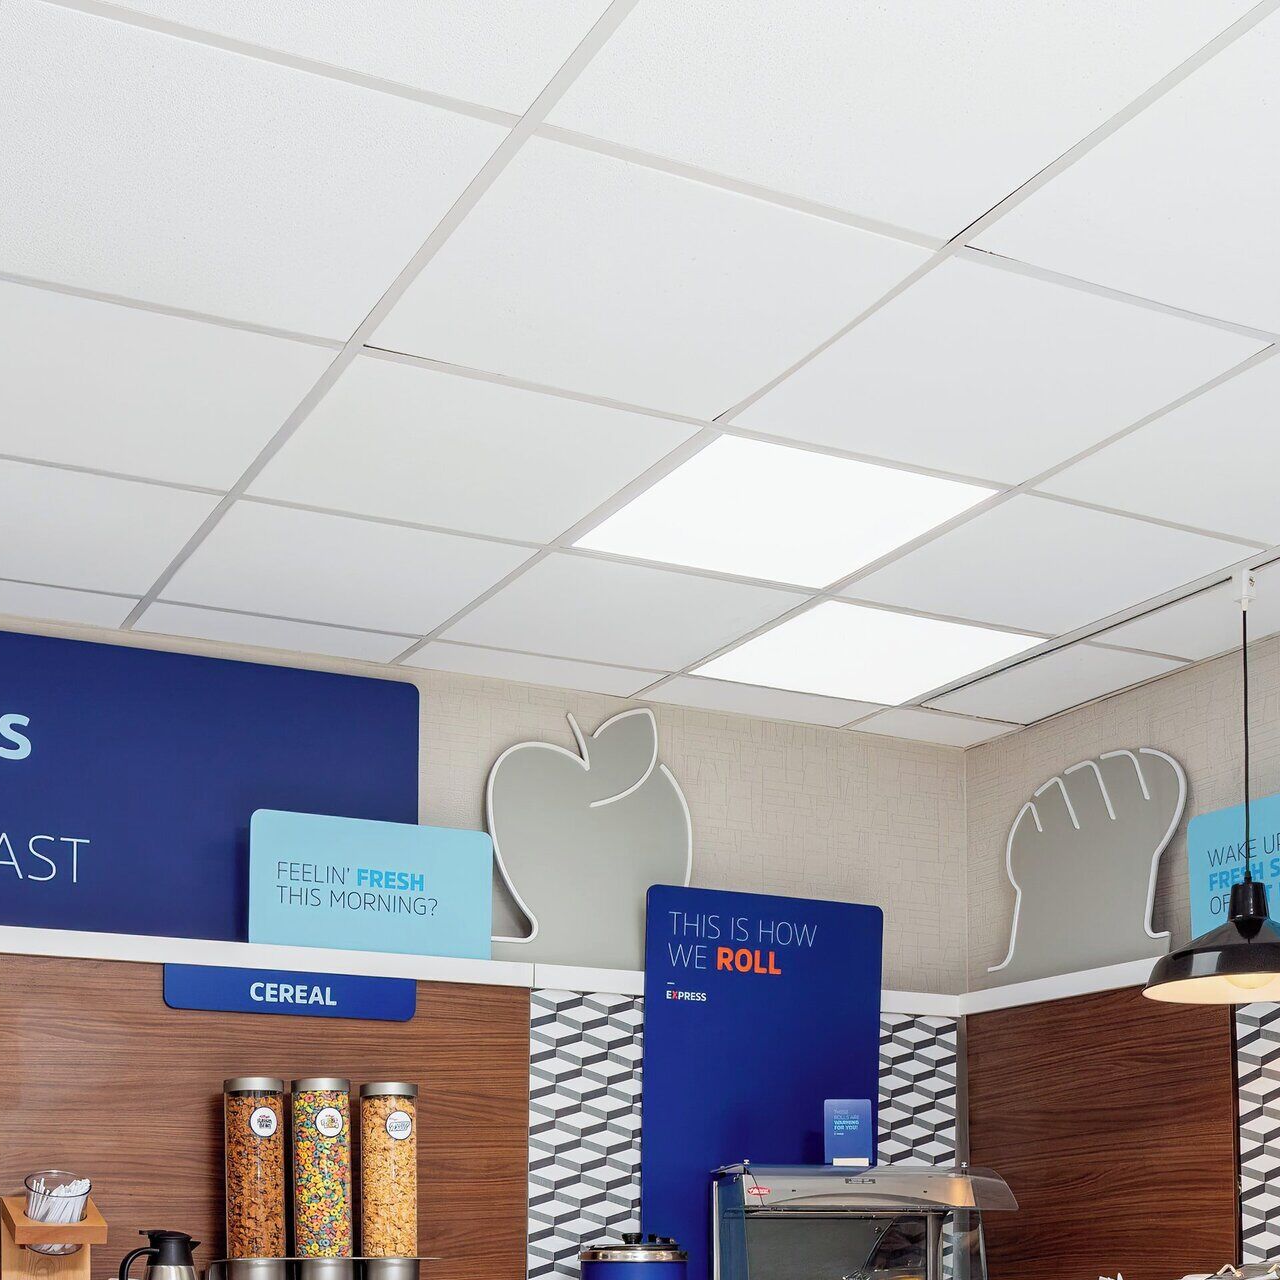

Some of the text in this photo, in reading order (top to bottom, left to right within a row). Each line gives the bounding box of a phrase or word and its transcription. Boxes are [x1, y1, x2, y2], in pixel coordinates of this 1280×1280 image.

[1207, 838, 1258, 868] WAKE
[276, 861, 424, 892] FEELIN' FRESH
[1209, 861, 1264, 892] FREH
[276, 885, 438, 916] THIS MORNING?
[1210, 893, 1231, 915] OF
[668, 911, 818, 948] THIS IS HOW
[668, 942, 782, 975] WE ROLL
[249, 982, 338, 1006] CEREAL
[666, 990, 707, 1002] EXPRESS
